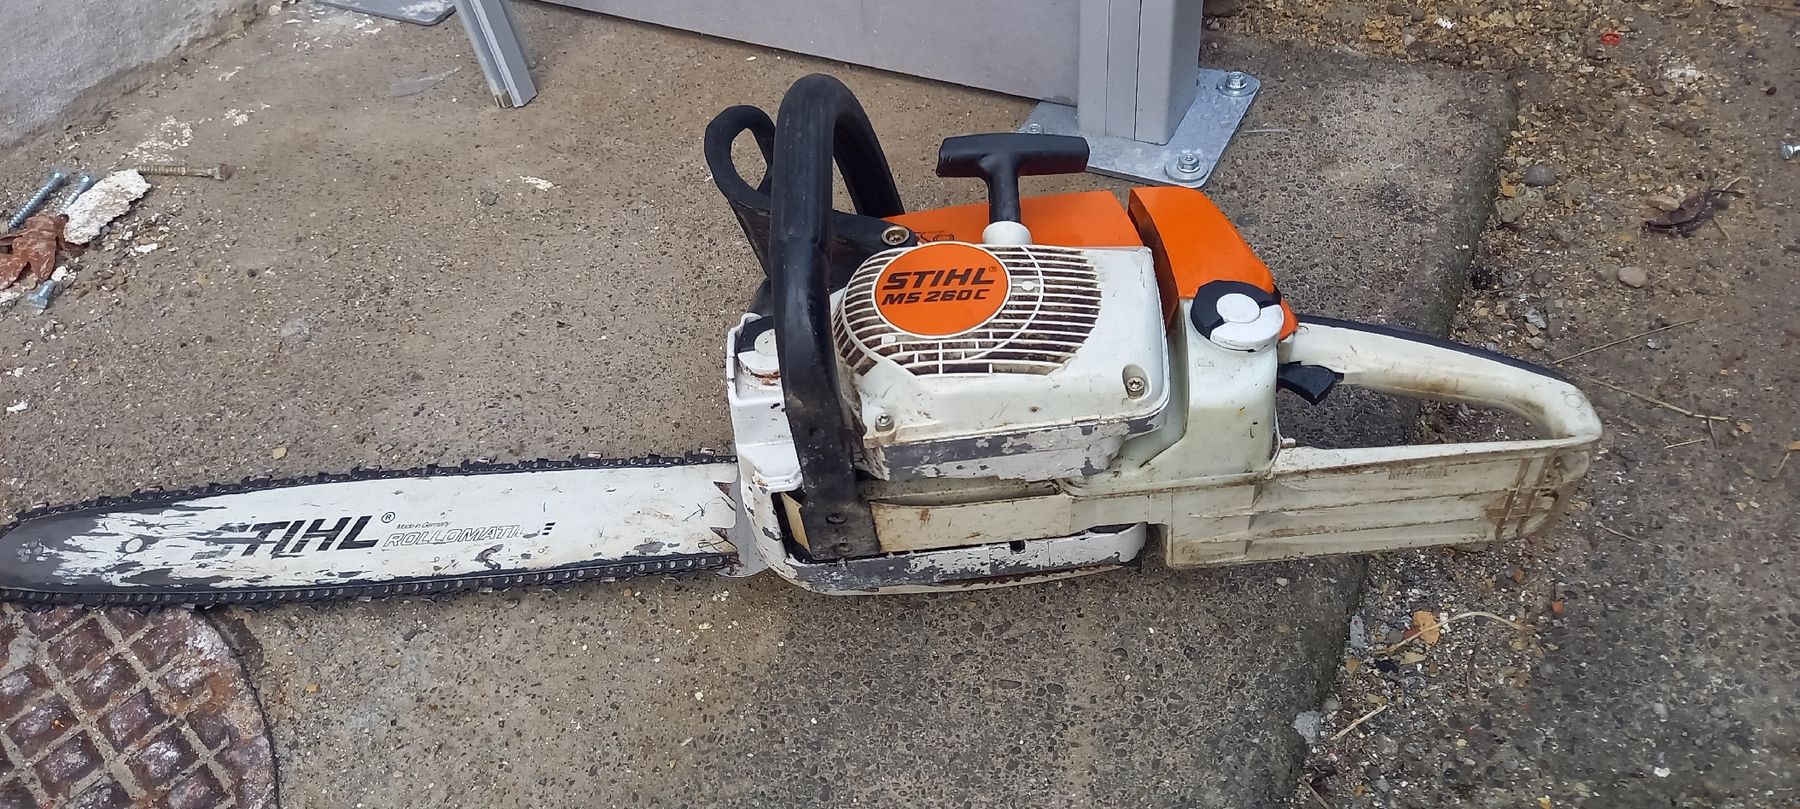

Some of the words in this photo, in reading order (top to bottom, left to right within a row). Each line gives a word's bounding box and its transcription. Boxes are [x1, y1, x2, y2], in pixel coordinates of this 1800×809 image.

[882, 267, 995, 291] STIHL
[881, 291, 922, 305] MS
[421, 521, 452, 529] Germany
[382, 524, 540, 547] ROLLOMATI
